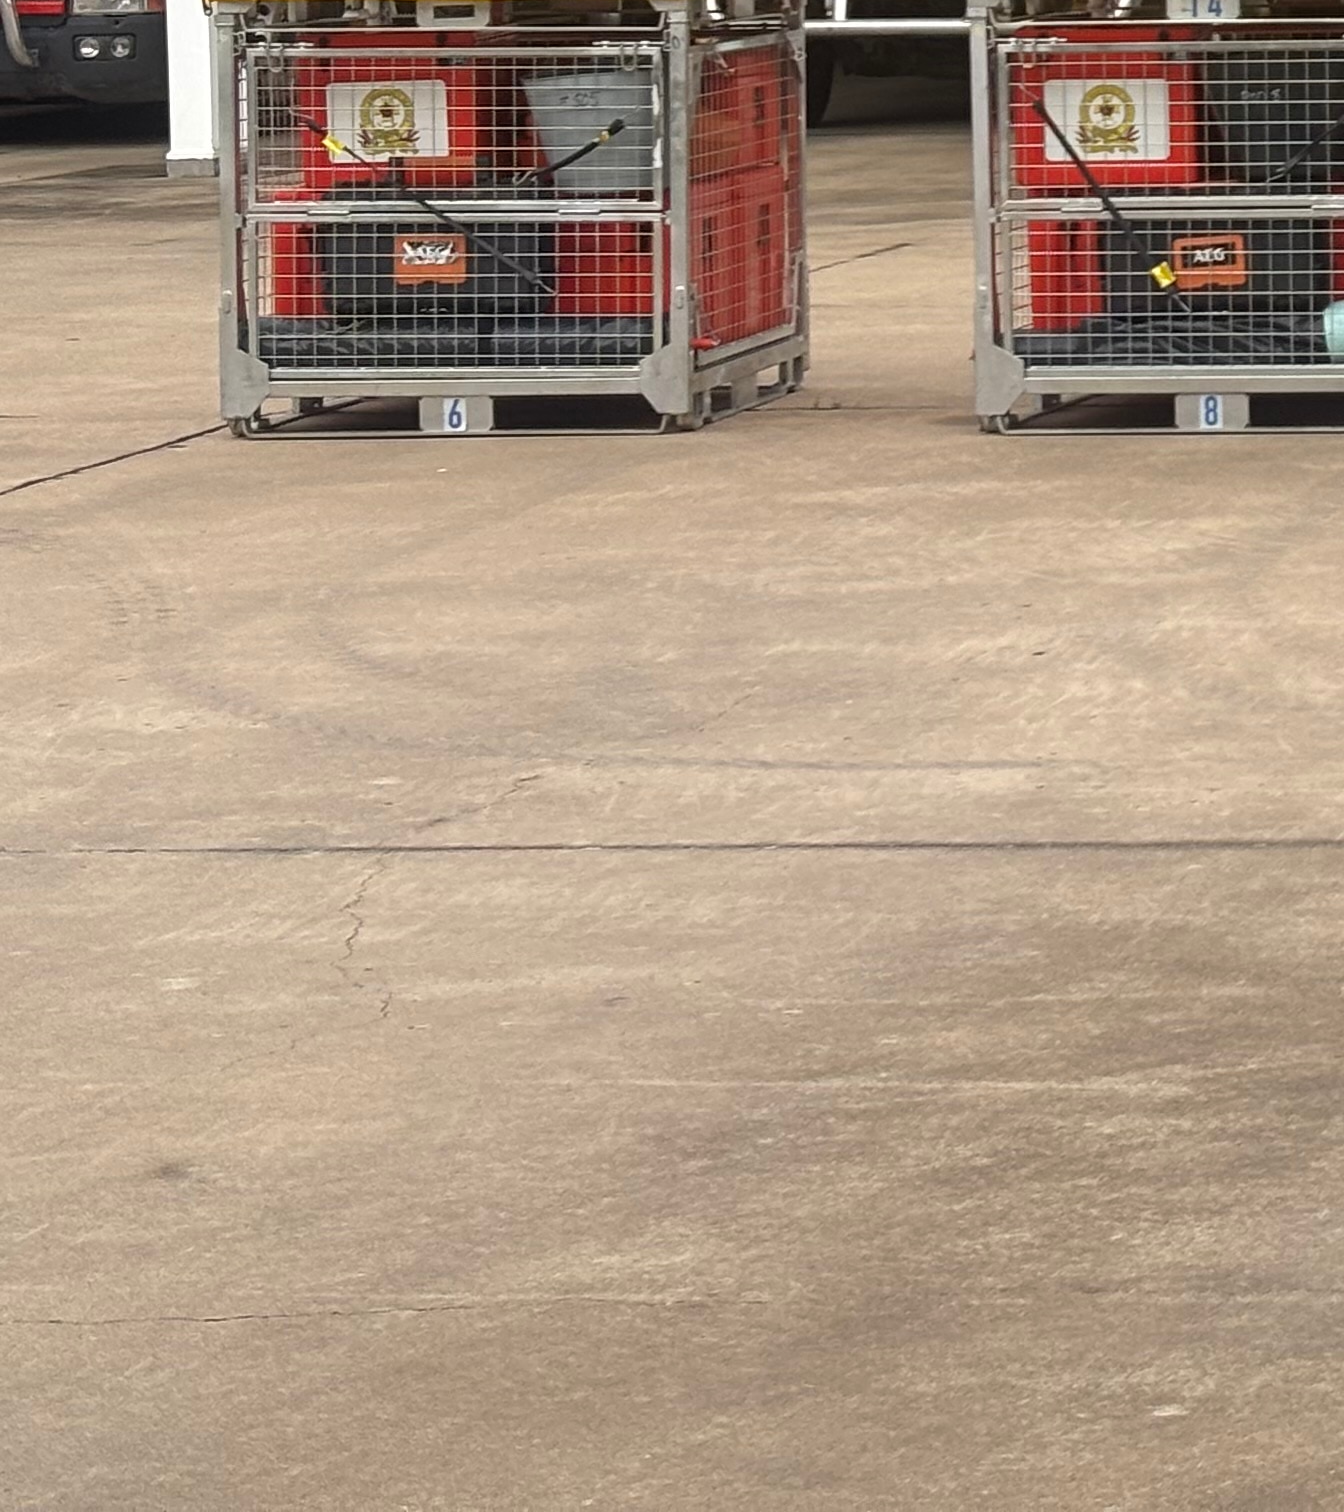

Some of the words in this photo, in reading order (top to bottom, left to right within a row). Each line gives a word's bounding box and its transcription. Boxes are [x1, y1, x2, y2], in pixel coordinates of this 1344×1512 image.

[1193, 248, 1226, 263] AEG
[448, 398, 462, 429] 6
[1205, 395, 1218, 426] 8
